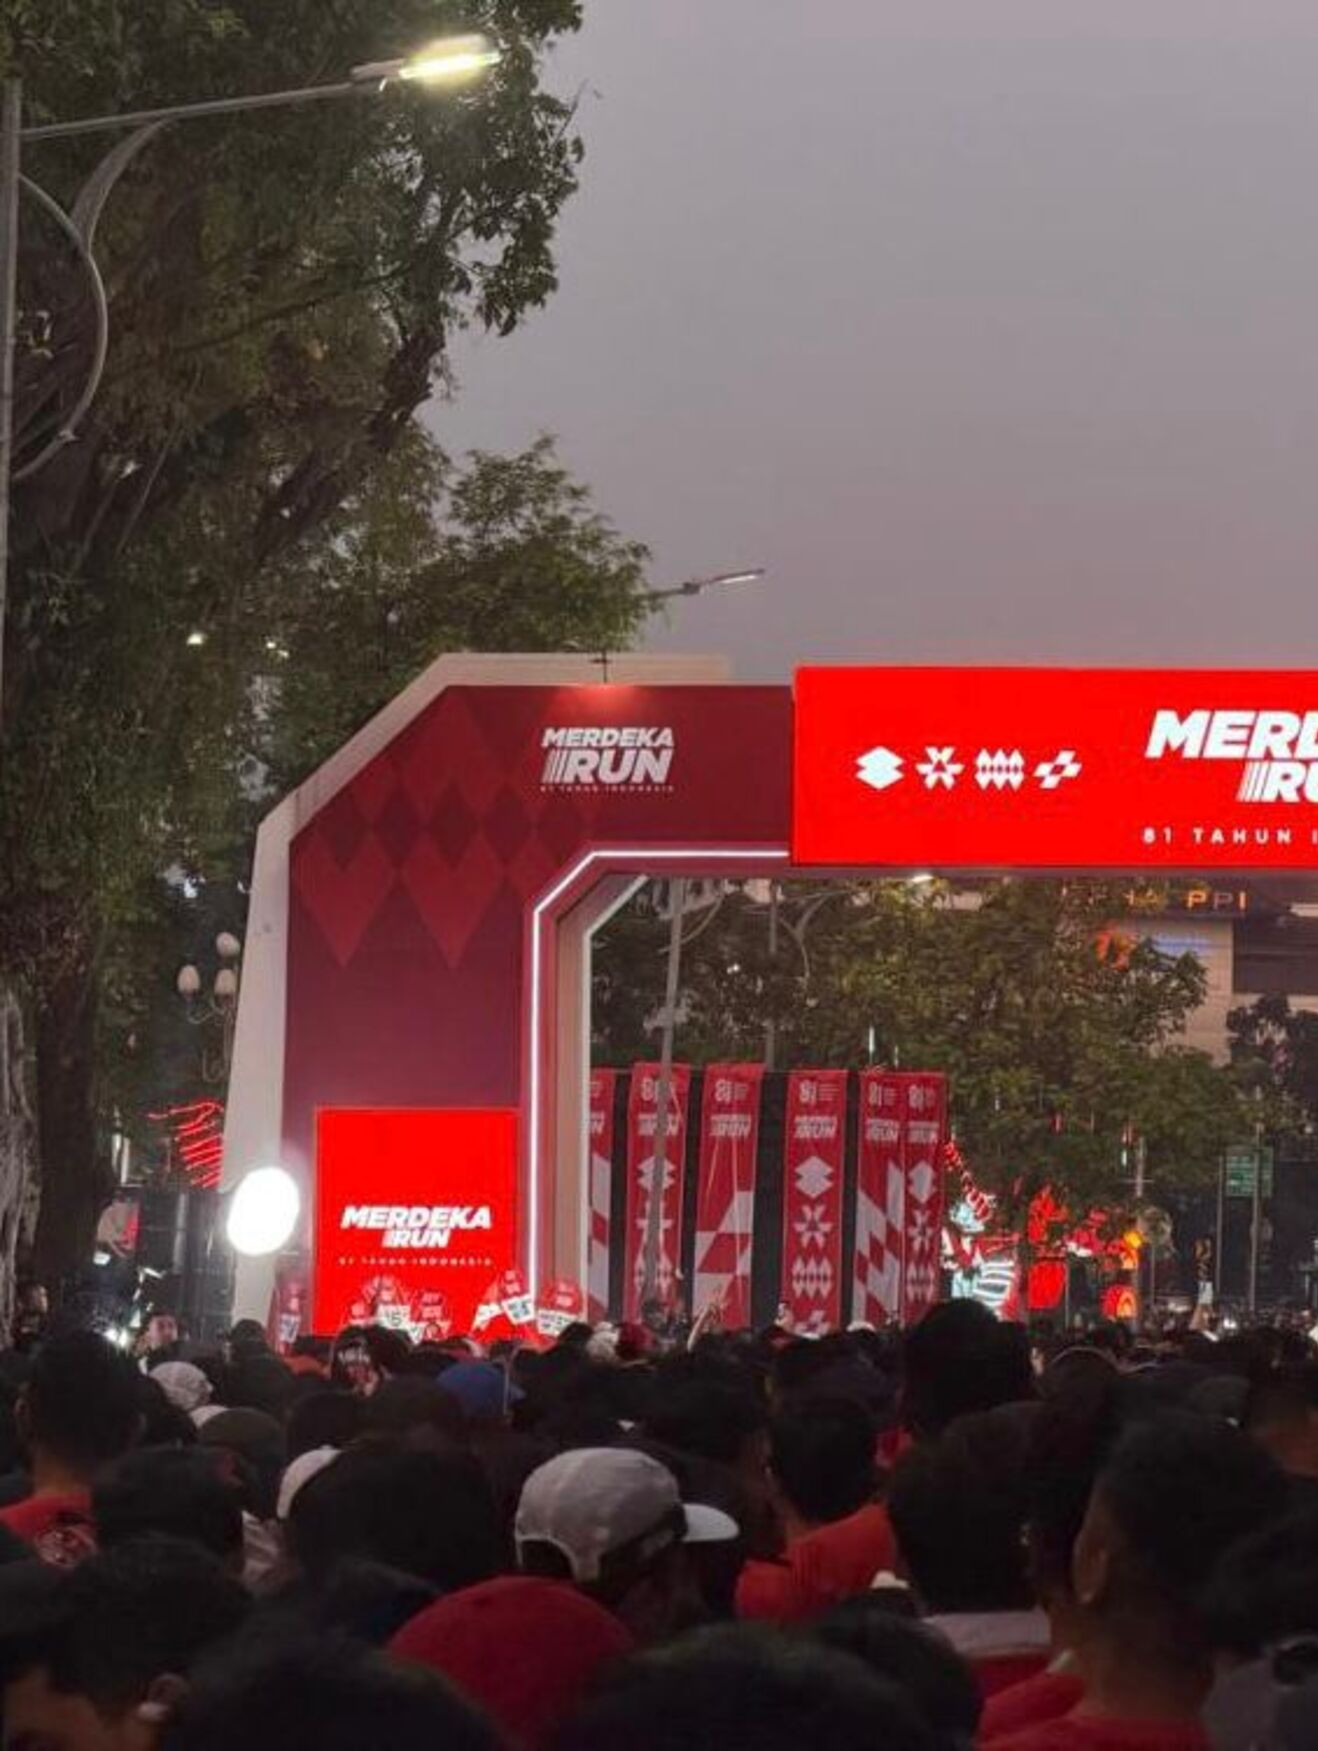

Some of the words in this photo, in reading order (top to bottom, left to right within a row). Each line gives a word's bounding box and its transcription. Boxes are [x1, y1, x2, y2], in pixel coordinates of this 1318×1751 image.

[541, 726, 674, 748] MERDEKA
[542, 748, 674, 784] RUN
[1143, 828, 1172, 844] 81
[1193, 828, 1291, 844] TAHUN
[340, 1205, 491, 1229] MERDEKA
[381, 1229, 451, 1248] RUN
